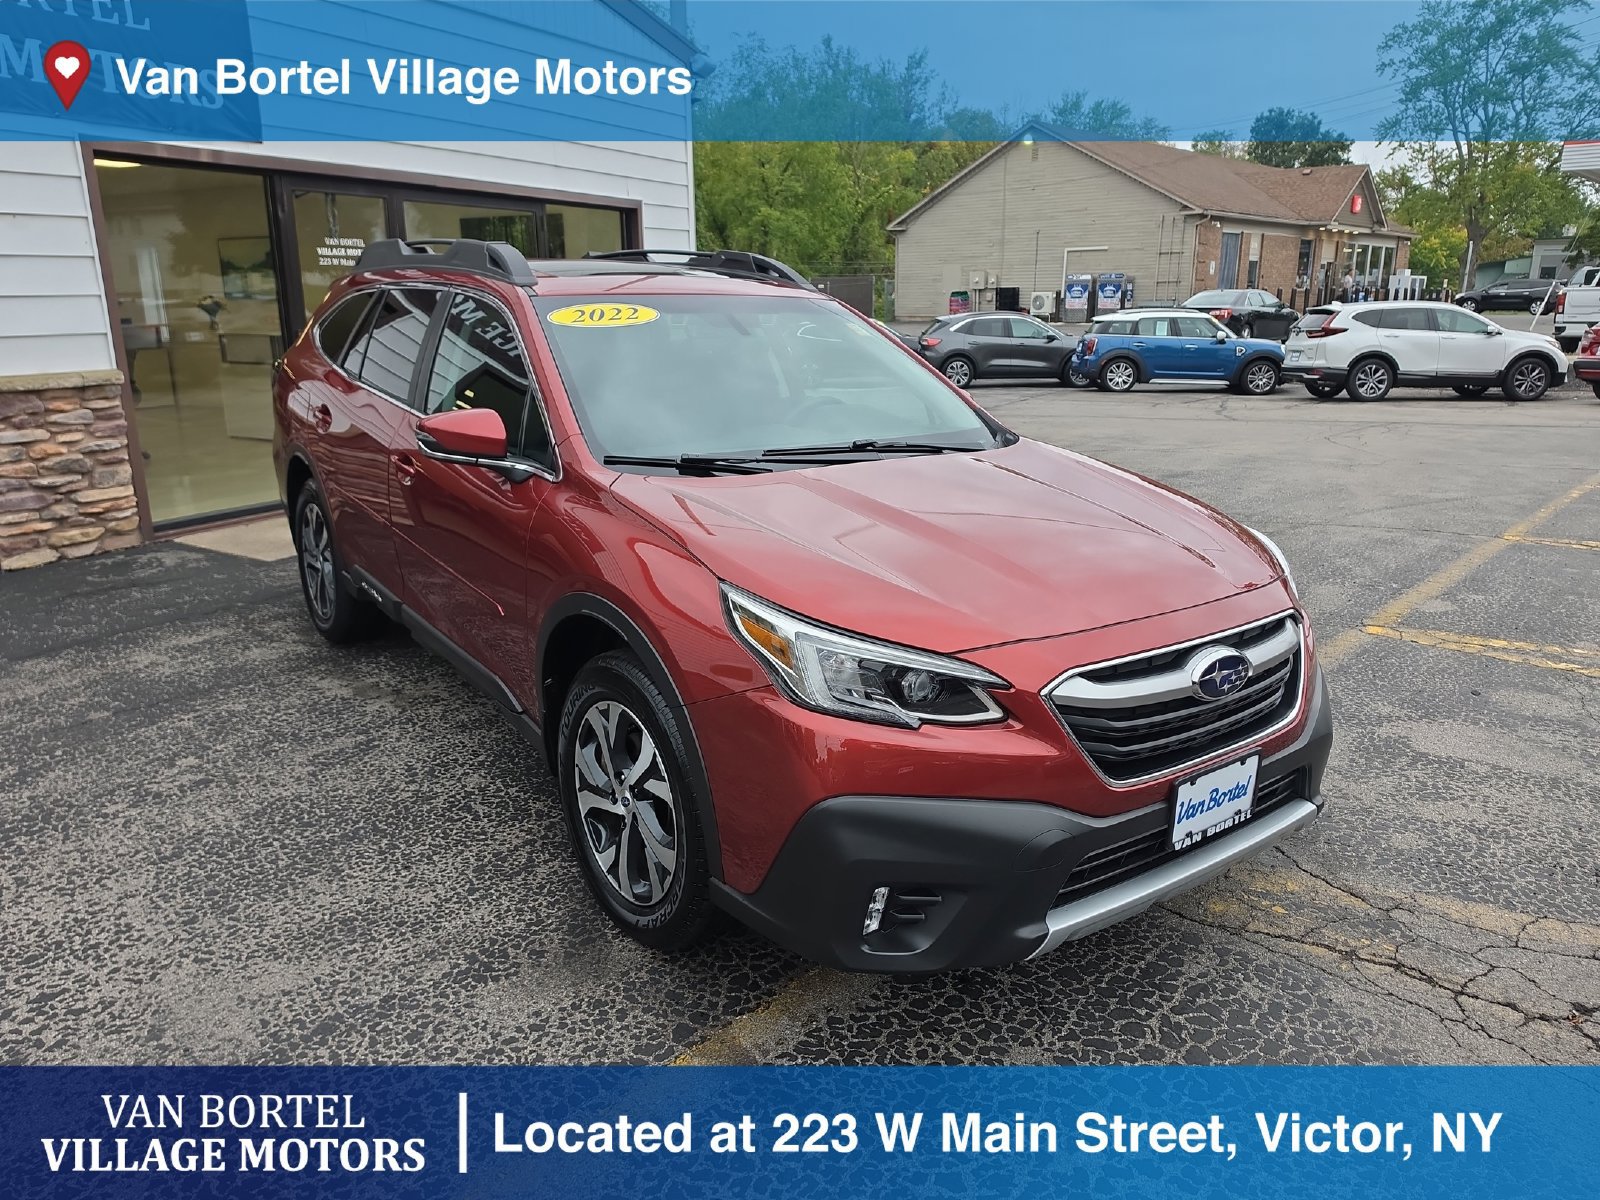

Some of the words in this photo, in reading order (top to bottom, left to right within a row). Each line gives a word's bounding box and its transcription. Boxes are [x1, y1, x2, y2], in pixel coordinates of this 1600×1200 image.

[0, 33, 224, 110] MTORS
[324, 237, 339, 245] VAN
[340, 238, 366, 248] BORTEL
[316, 247, 346, 256] VILLAGE
[319, 257, 332, 266] 223
[332, 257, 340, 265] W
[571, 307, 640, 323] 2022
[1174, 831, 1202, 851] VAN
[1207, 809, 1254, 838] BORTEL
